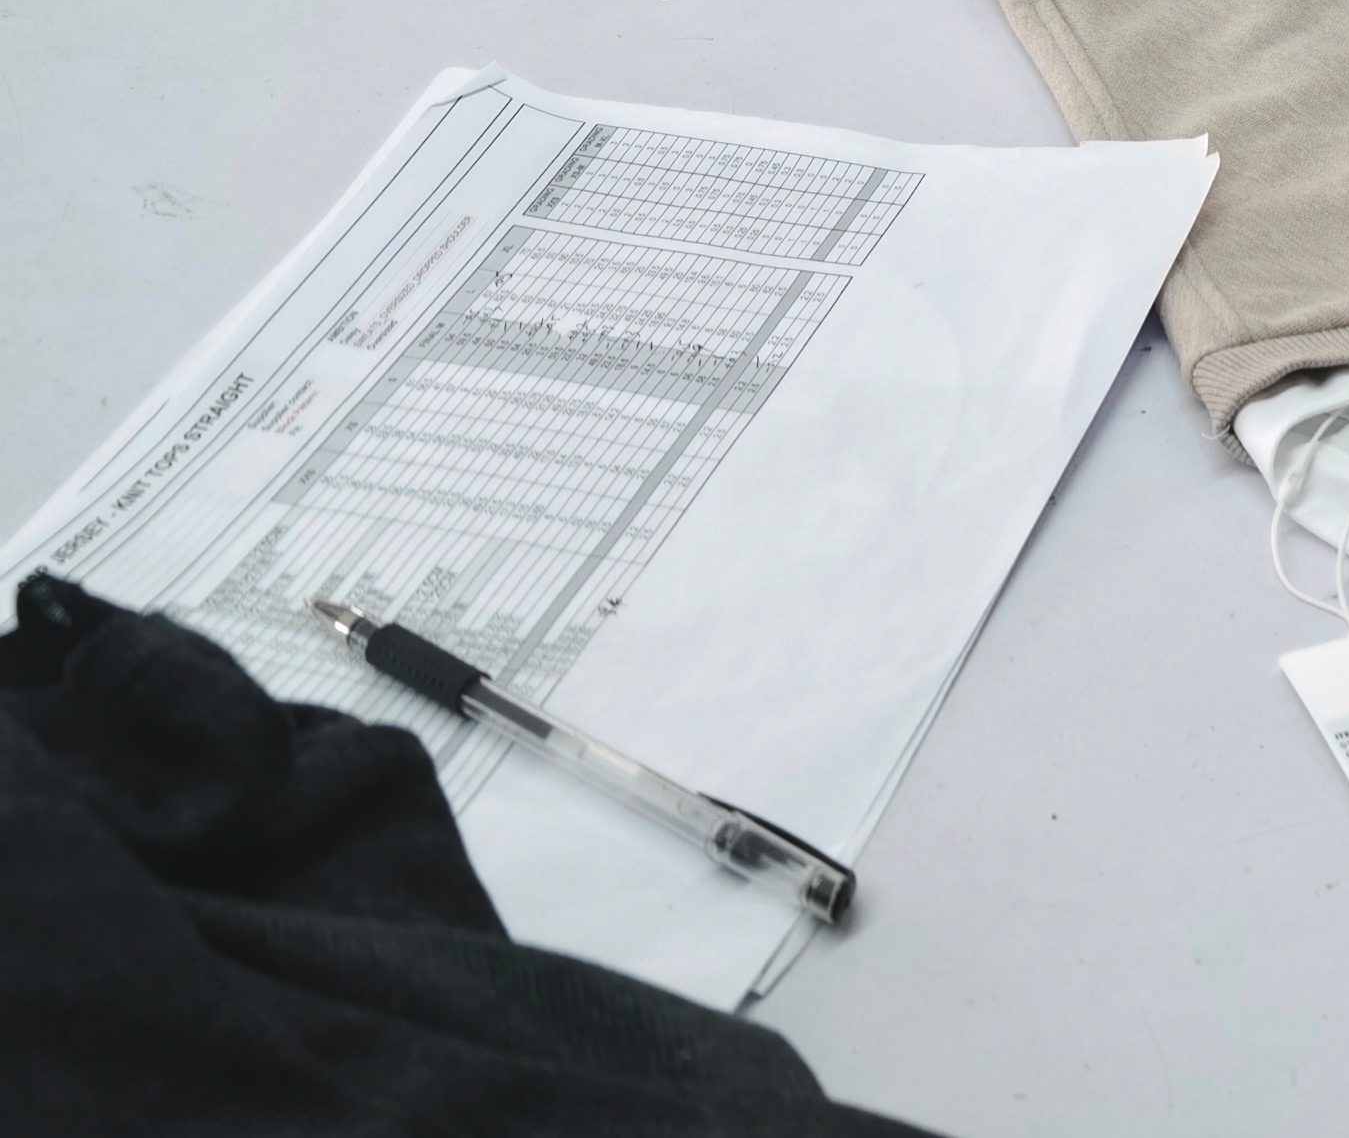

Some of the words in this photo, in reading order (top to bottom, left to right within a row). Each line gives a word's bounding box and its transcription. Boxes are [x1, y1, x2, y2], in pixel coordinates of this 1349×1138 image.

[53, 516, 109, 565] JERSEY
[113, 479, 151, 511] KNIT
[145, 443, 189, 477] TOPS
[184, 372, 254, 441] STRAIGHT
